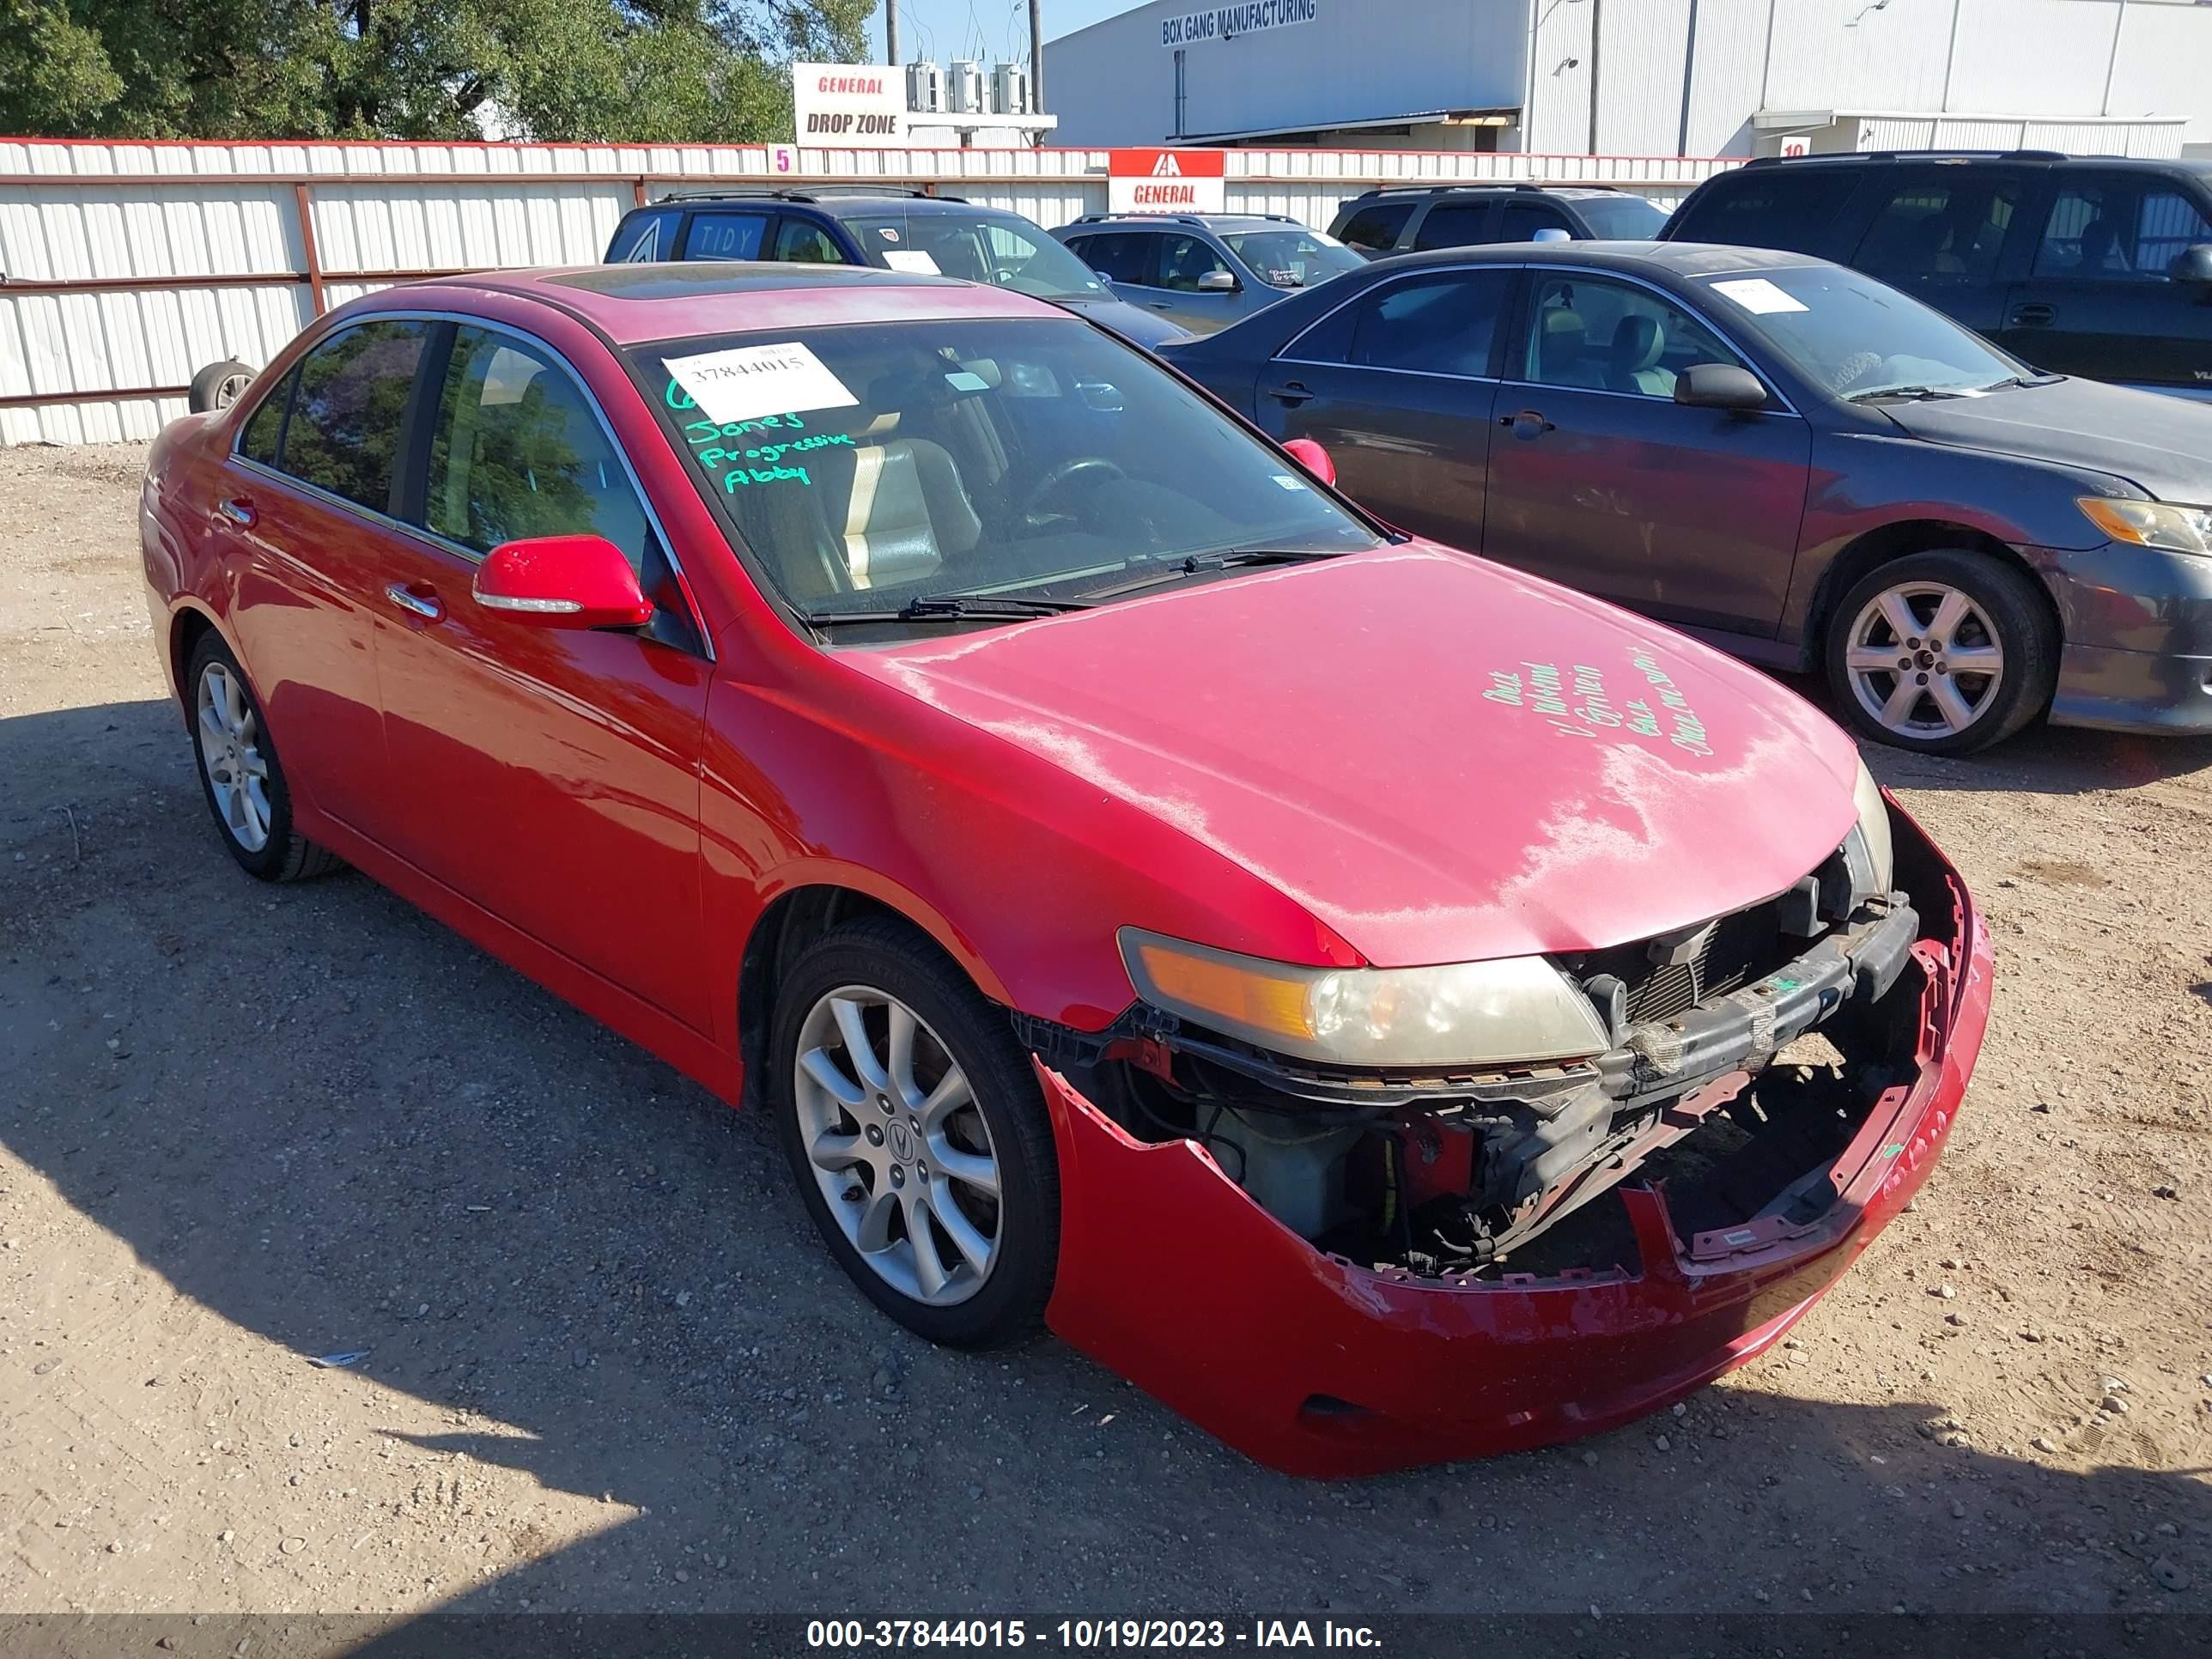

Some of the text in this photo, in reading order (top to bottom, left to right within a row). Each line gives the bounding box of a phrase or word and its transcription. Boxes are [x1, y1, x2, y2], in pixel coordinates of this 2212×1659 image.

[1163, 0, 1316, 45] BOX GANG MANUFACTURING
[818, 76, 884, 94] GENERAL
[807, 113, 897, 134] DROP ZONE
[776, 149, 789, 172] 5
[1134, 185, 1195, 204] GENERAL
[701, 226, 752, 254] TIDY
[690, 356, 805, 383] 37844015
[685, 412, 805, 444] Jones
[700, 434, 856, 469] Progressive
[724, 466, 811, 494] Abby
